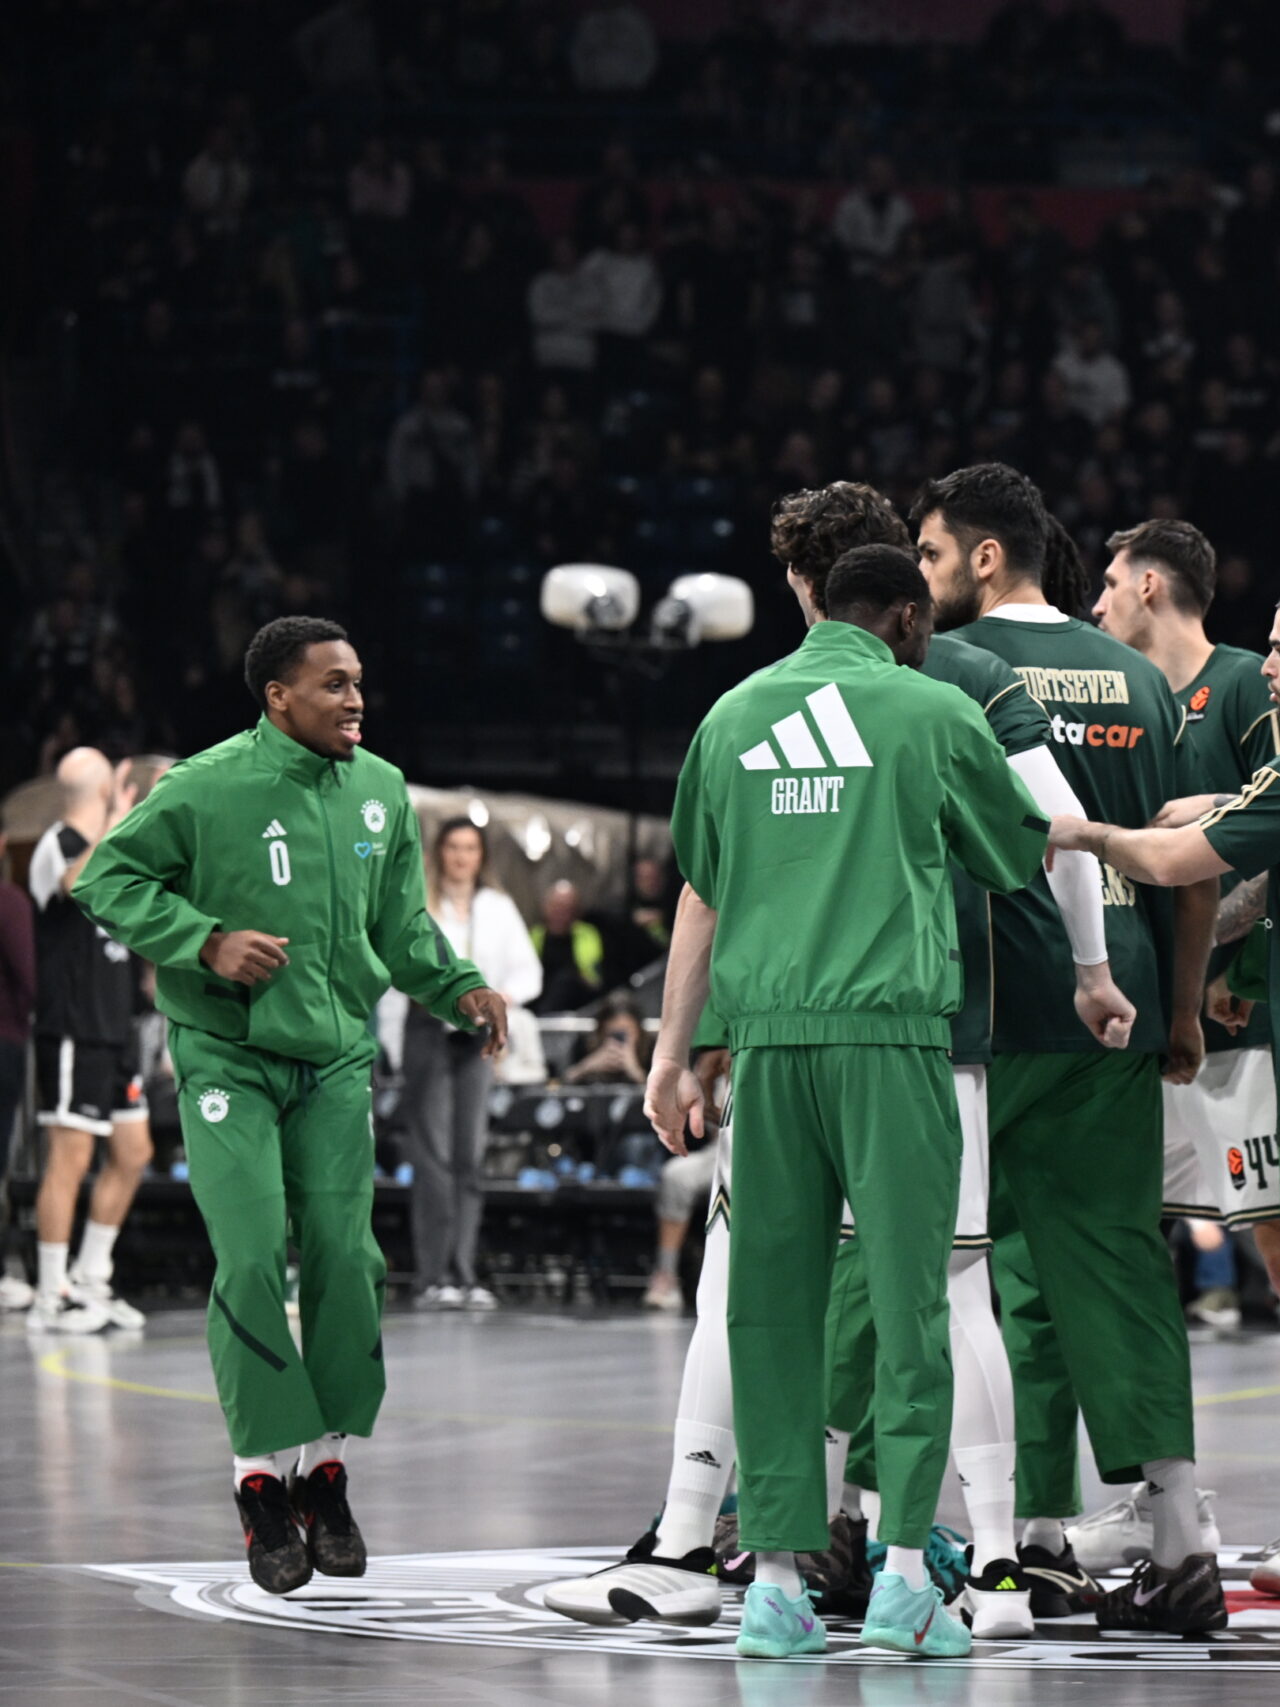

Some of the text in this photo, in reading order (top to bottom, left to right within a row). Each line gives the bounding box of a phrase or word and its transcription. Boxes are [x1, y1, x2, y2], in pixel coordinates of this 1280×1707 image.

[1051, 713, 1144, 749] tacar
[771, 776, 845, 815] GRANT
[269, 840, 291, 886] 0
